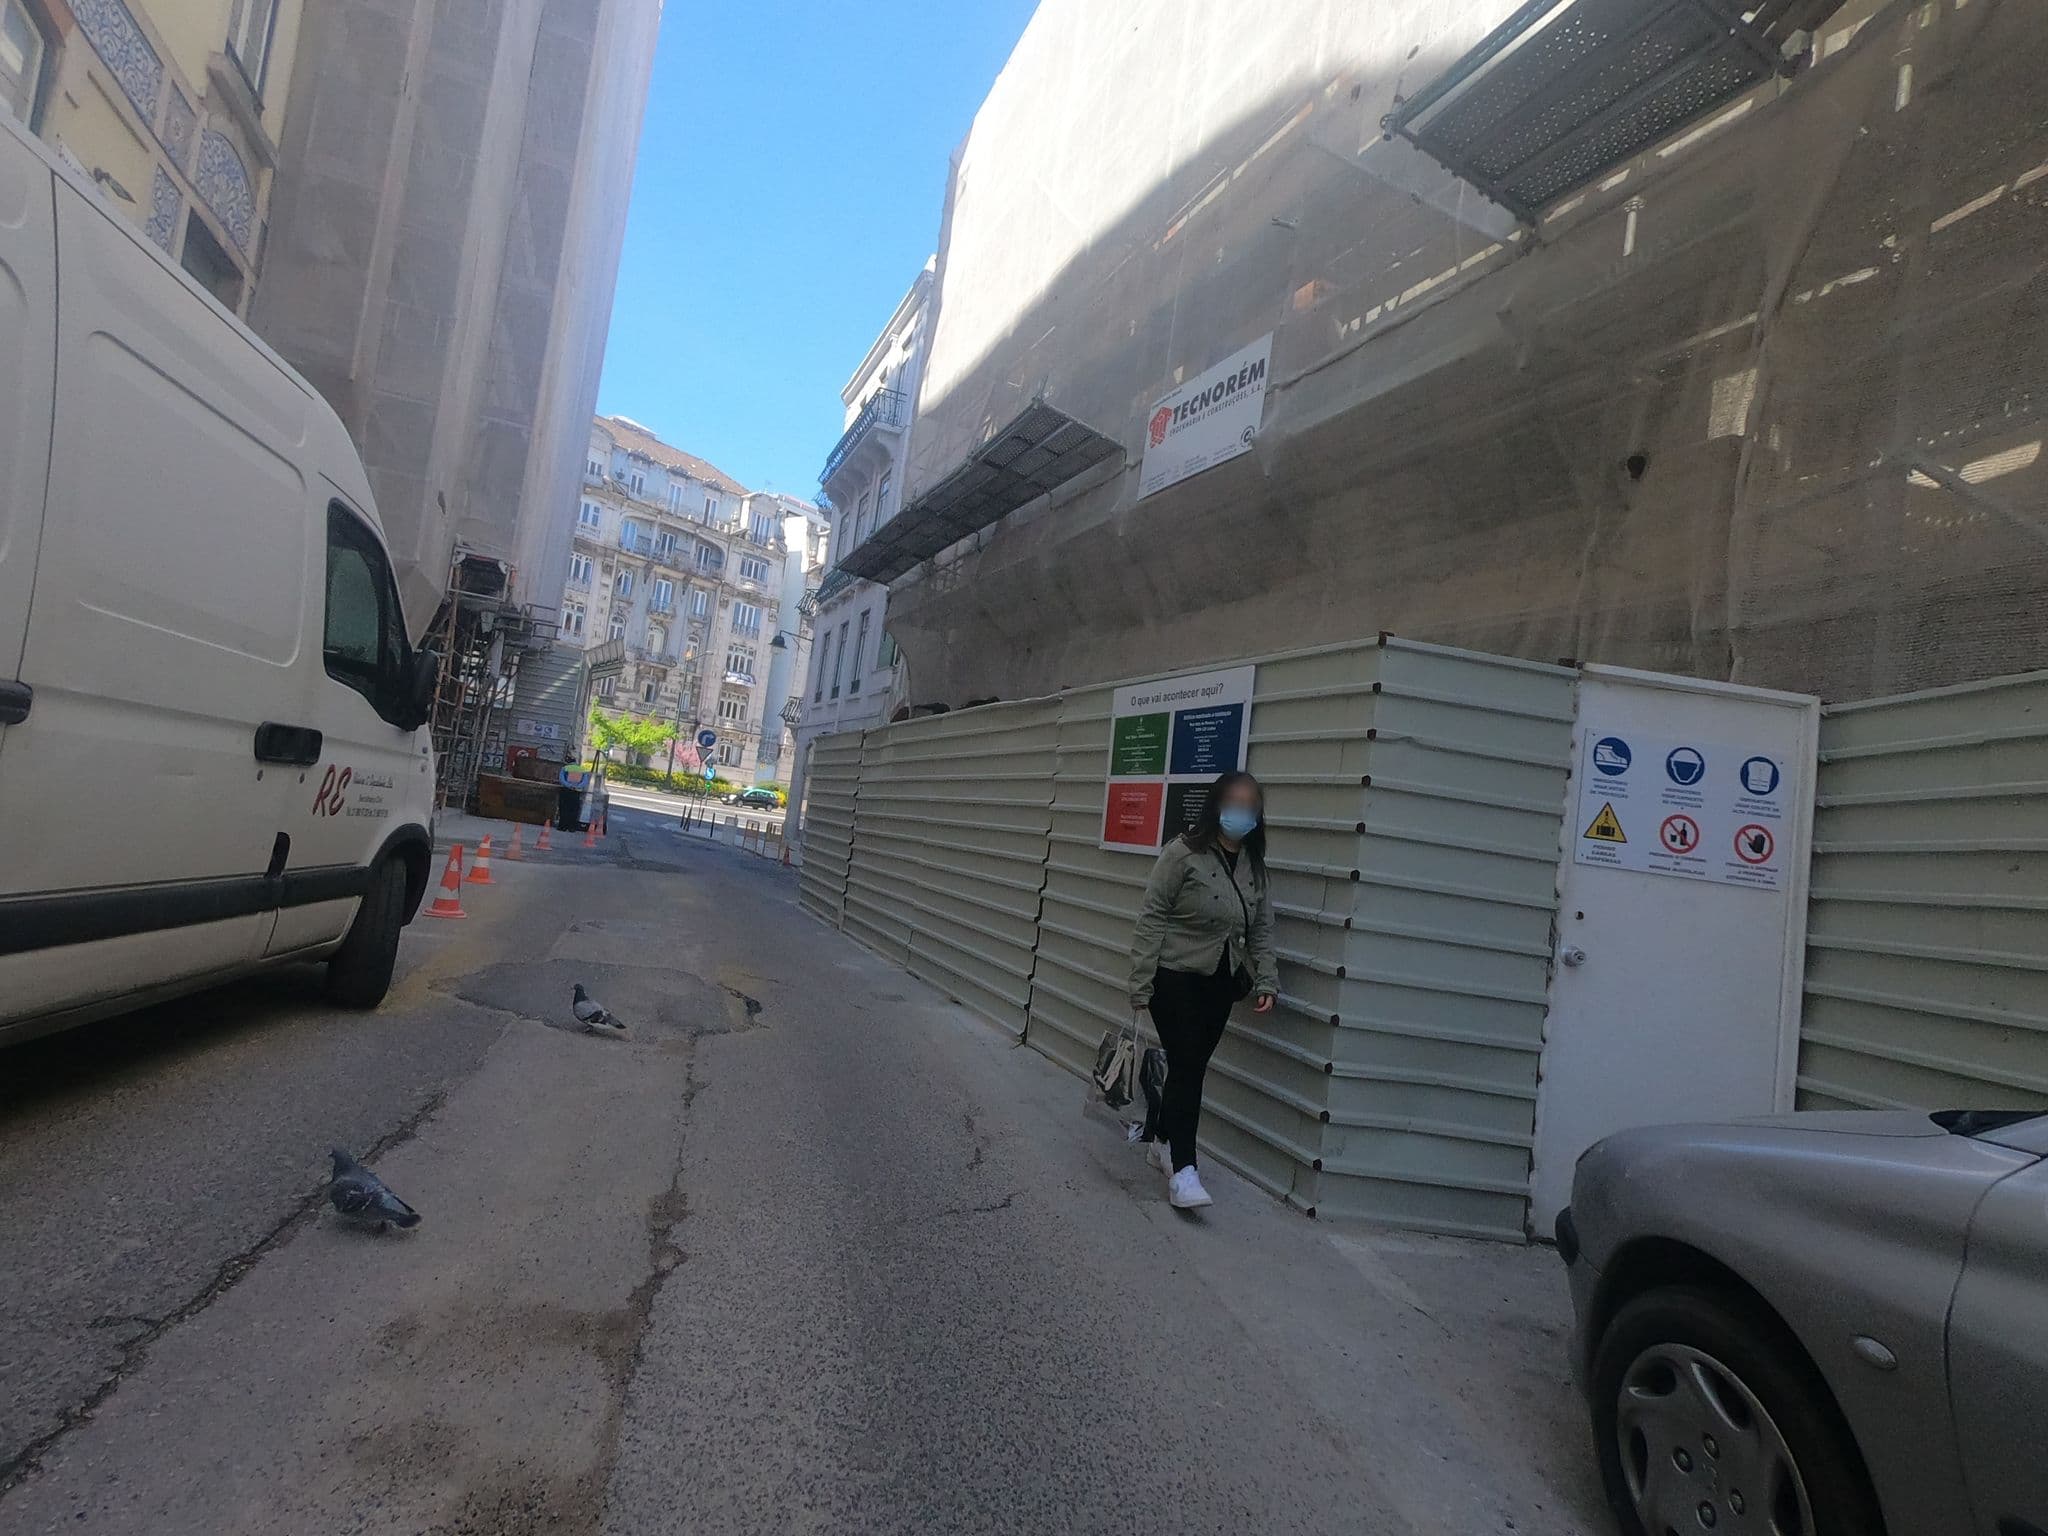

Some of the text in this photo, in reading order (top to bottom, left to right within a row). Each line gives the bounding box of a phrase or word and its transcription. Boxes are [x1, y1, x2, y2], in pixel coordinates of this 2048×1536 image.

[1172, 358, 1265, 425] TECNORÉM
[1131, 683, 1224, 708] O que vai acontecer aqui?
